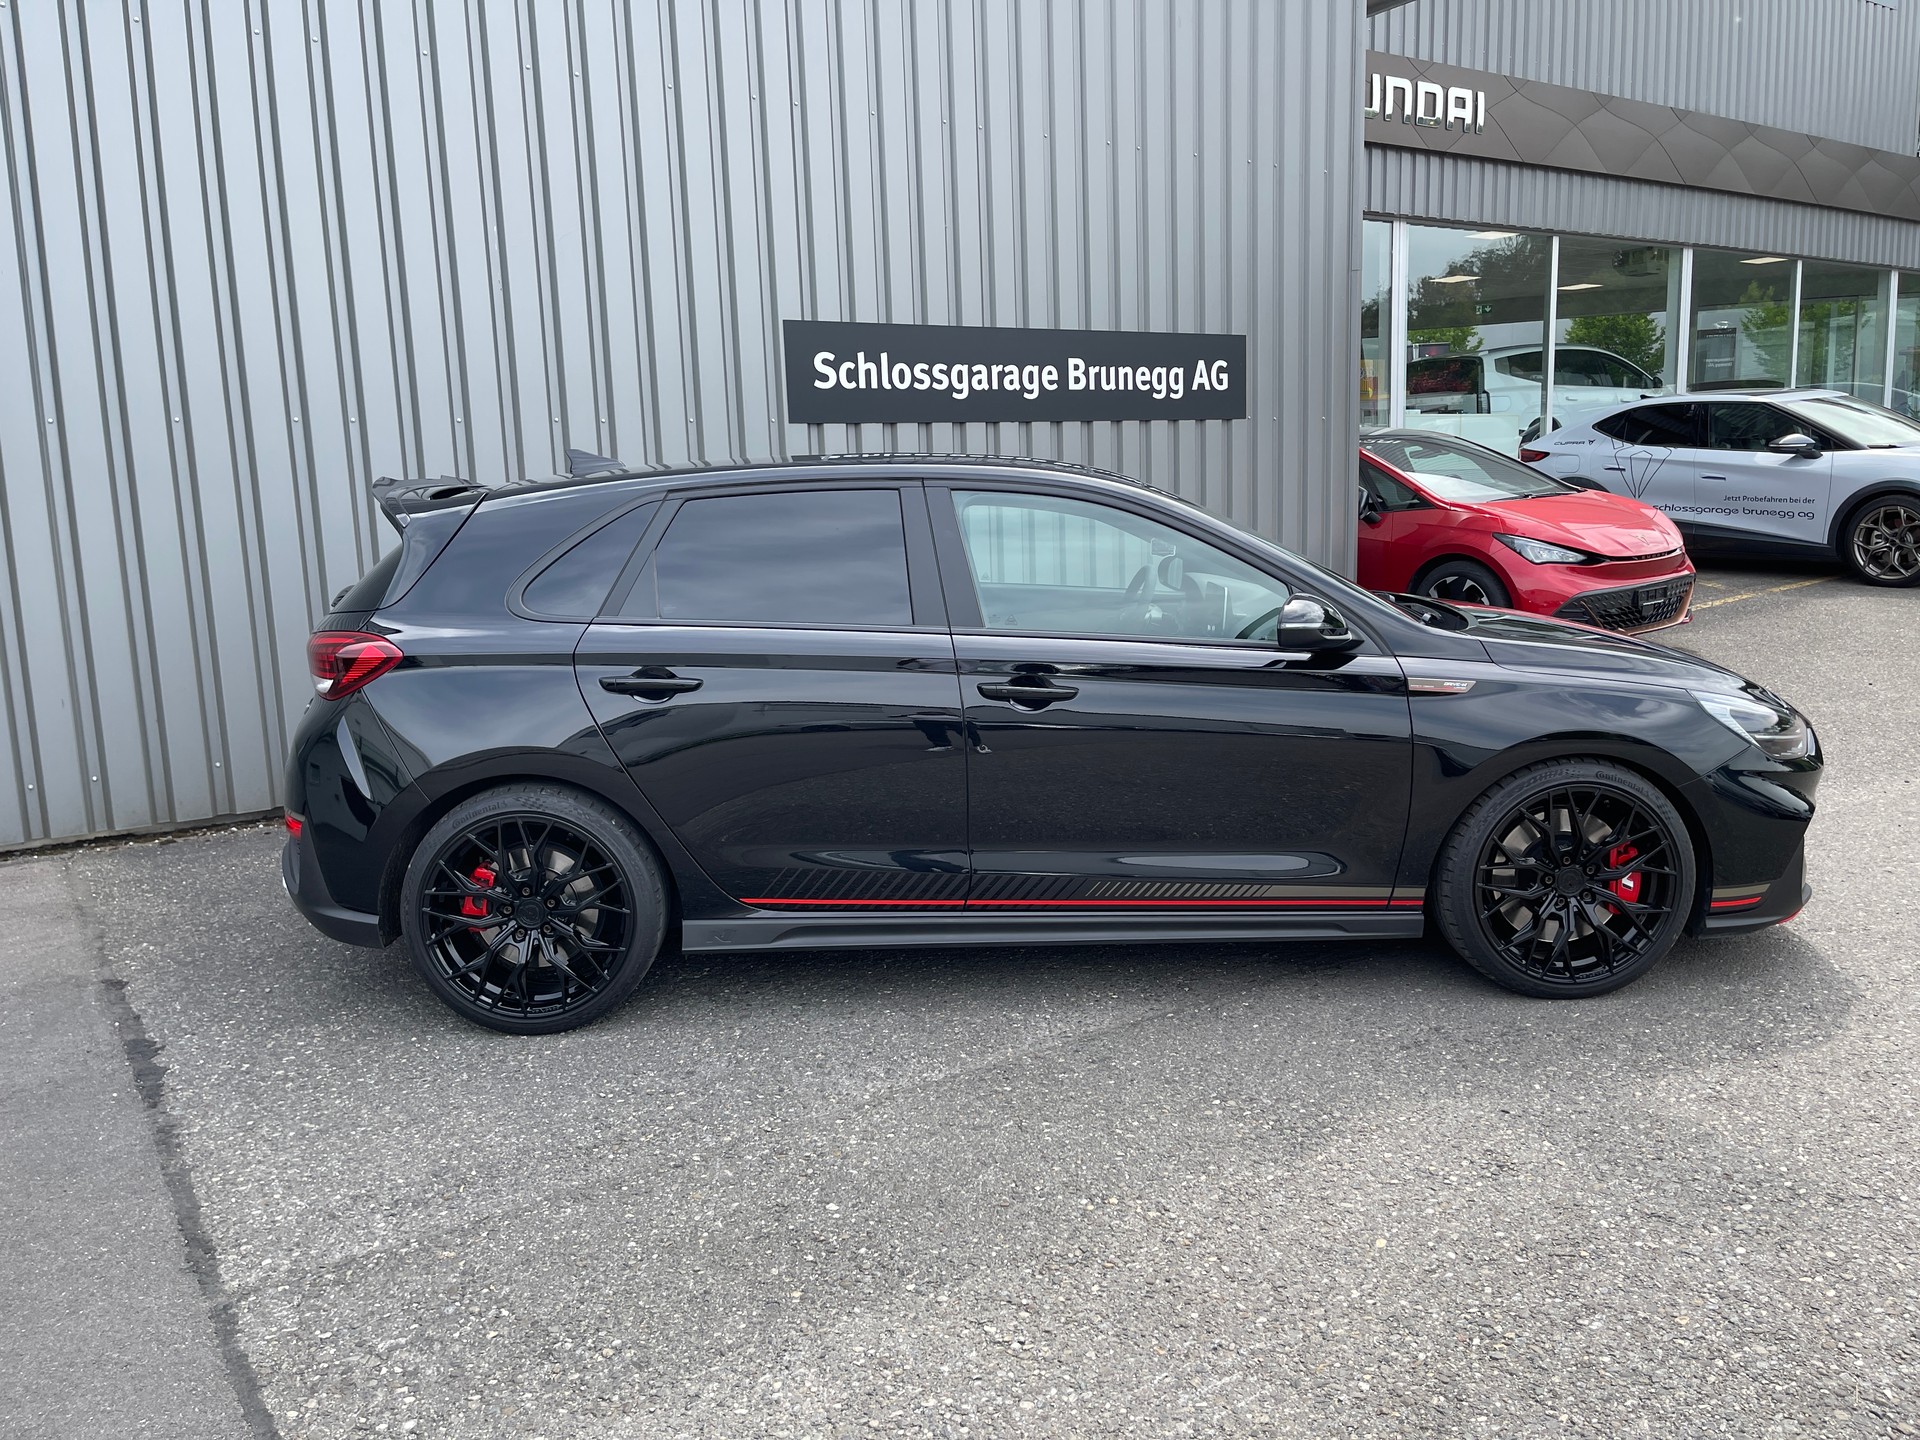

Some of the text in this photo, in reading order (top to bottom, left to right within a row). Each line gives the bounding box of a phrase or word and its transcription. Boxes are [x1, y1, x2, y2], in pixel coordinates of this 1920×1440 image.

[813, 351, 1229, 400] Schlossgarage Brunegg AG
[1742, 495, 1788, 503] Probefahren
[1789, 496, 1801, 504] bei
[1802, 496, 1816, 504] der
[1742, 507, 1795, 519] brunegg
[1797, 511, 1815, 520] ag
[1595, 770, 1645, 794] Continental
[452, 801, 501, 829] Continental
